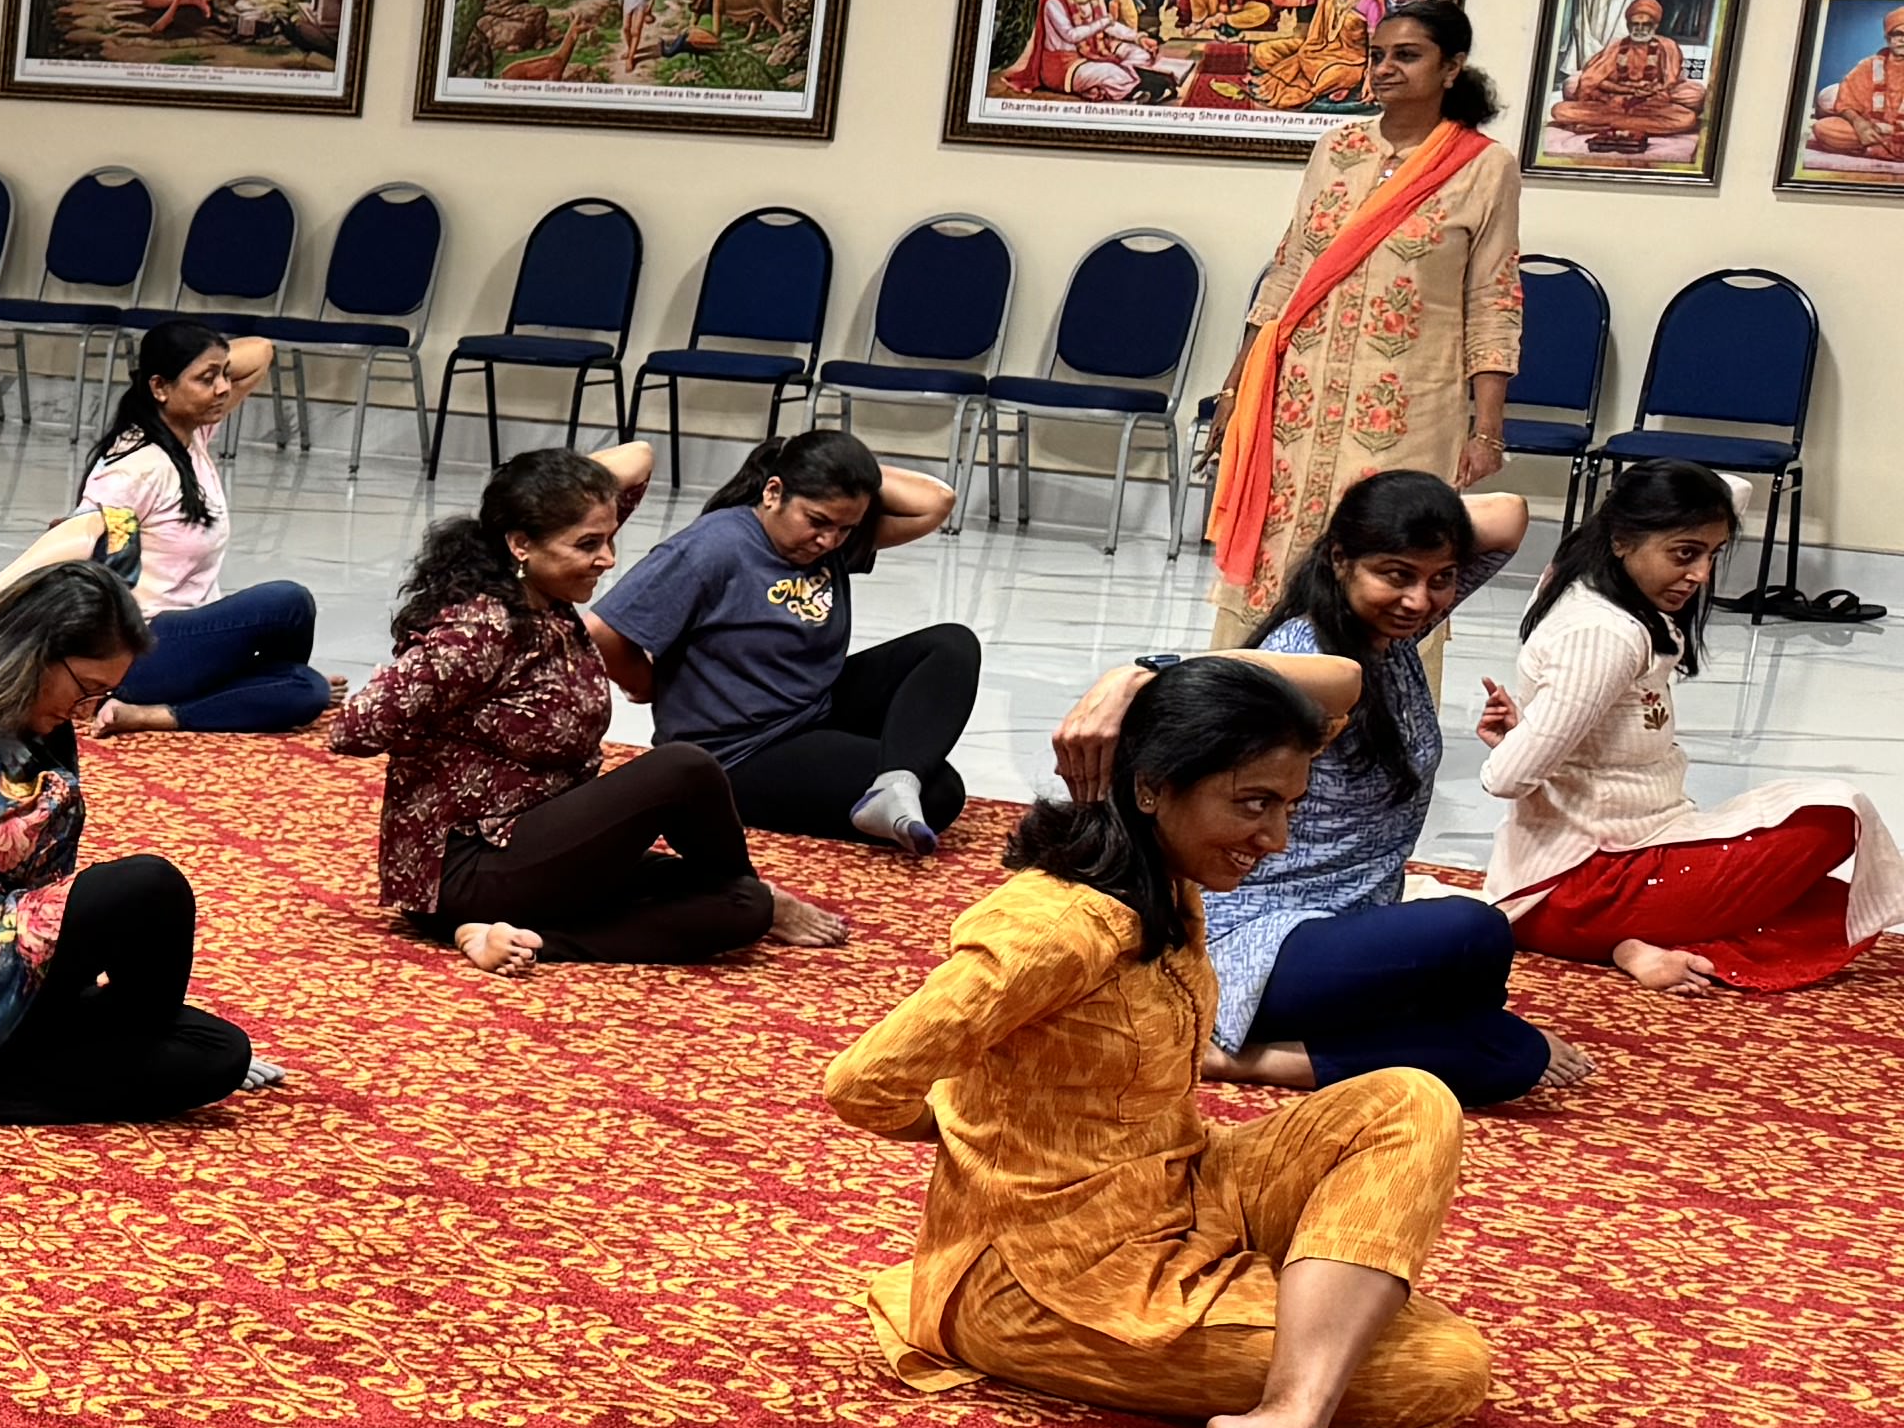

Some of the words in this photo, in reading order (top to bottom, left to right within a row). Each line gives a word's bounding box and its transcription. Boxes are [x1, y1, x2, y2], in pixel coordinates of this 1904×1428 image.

[484, 81, 499, 90] The
[501, 82, 542, 92] Supreme
[544, 83, 584, 93] Godhead
[686, 90, 701, 99] the
[703, 91, 732, 100] dense
[1001, 101, 1060, 113] Dharmadev
[1063, 104, 1082, 114] and
[1085, 105, 1145, 117] Bhaktimata
[1148, 108, 1196, 121] swinging
[1198, 110, 1231, 122] Shree
[1234, 112, 1305, 127] Ghanashyam
